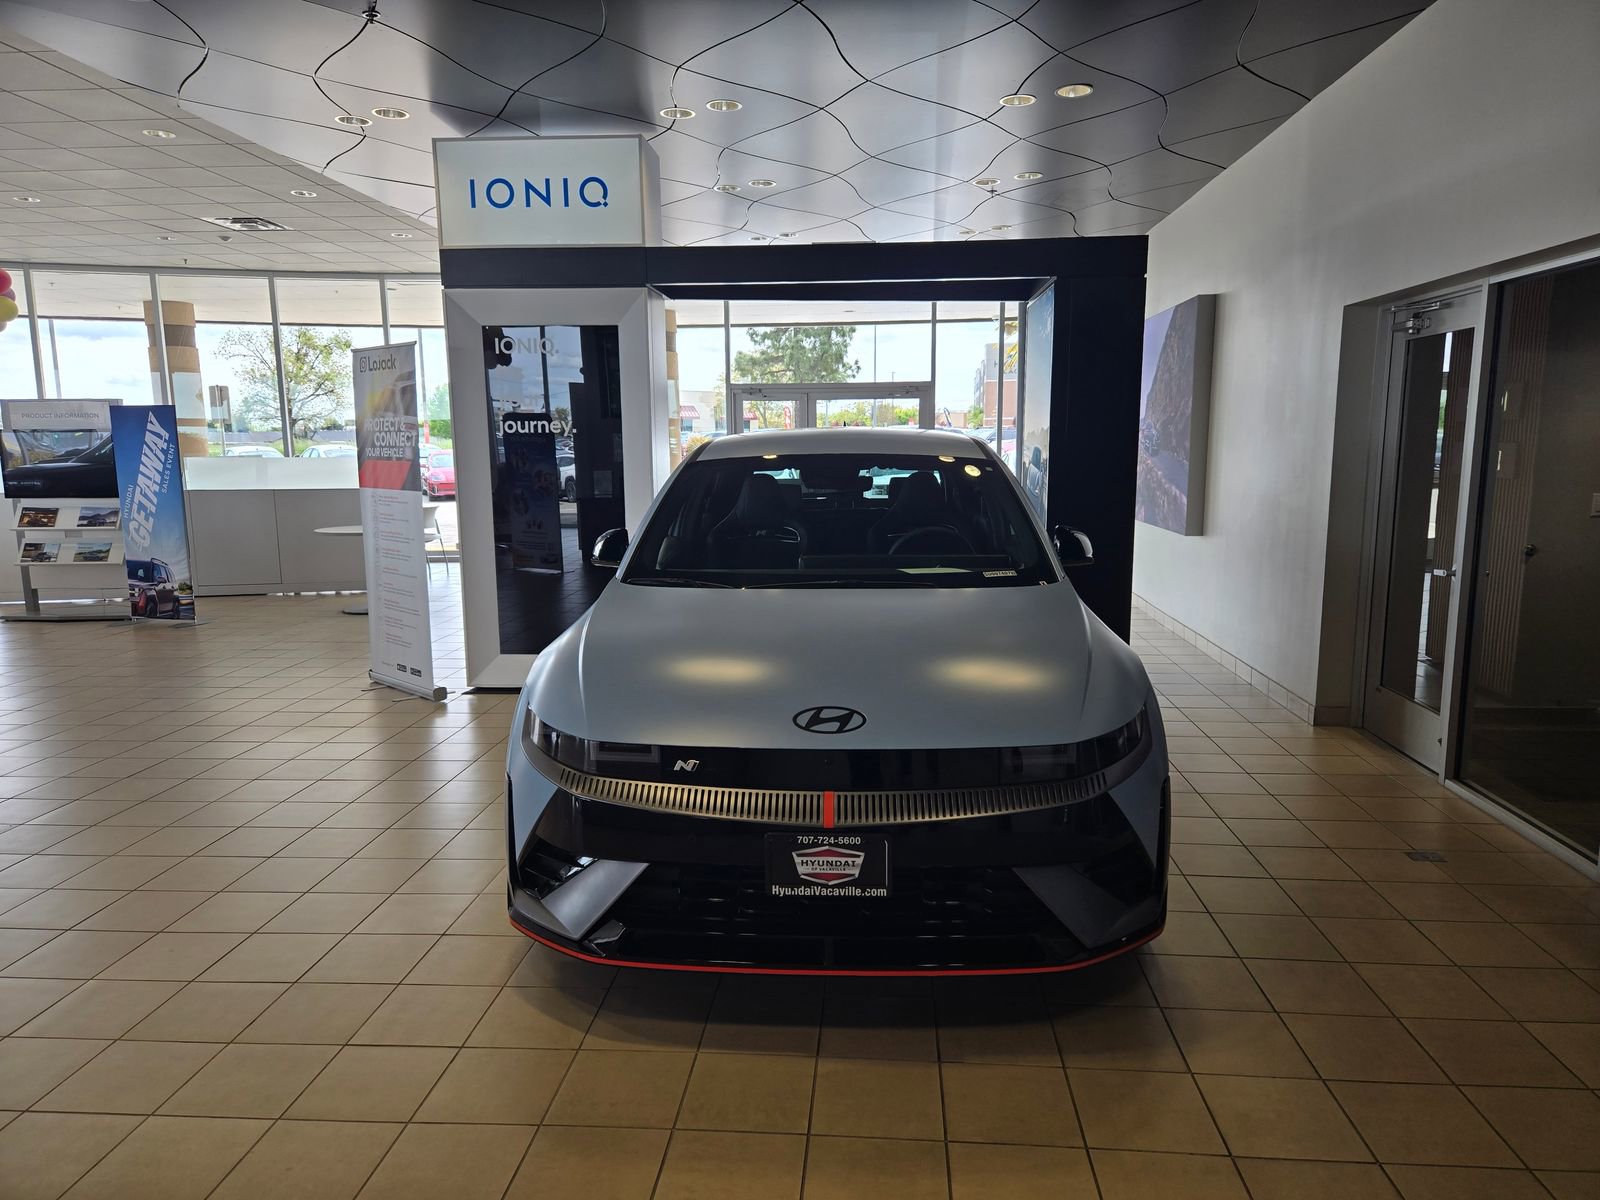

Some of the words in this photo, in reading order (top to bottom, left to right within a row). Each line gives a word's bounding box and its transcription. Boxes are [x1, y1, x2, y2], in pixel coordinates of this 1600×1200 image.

[469, 176, 609, 208] IONIQ
[364, 417, 400, 432] PROTECT
[374, 431, 417, 447] CONNECT
[365, 447, 381, 457] YOUR
[381, 447, 404, 458] VEHICLE
[161, 470, 171, 494] SALES
[168, 443, 176, 469] EVENT
[128, 410, 170, 551] GETAWAY
[123, 484, 134, 519] HYUNDAI
[796, 836, 861, 845] 707-724-5600
[800, 859, 857, 868] HYUNDAI
[772, 885, 887, 897] HyundaiVacaville.com
